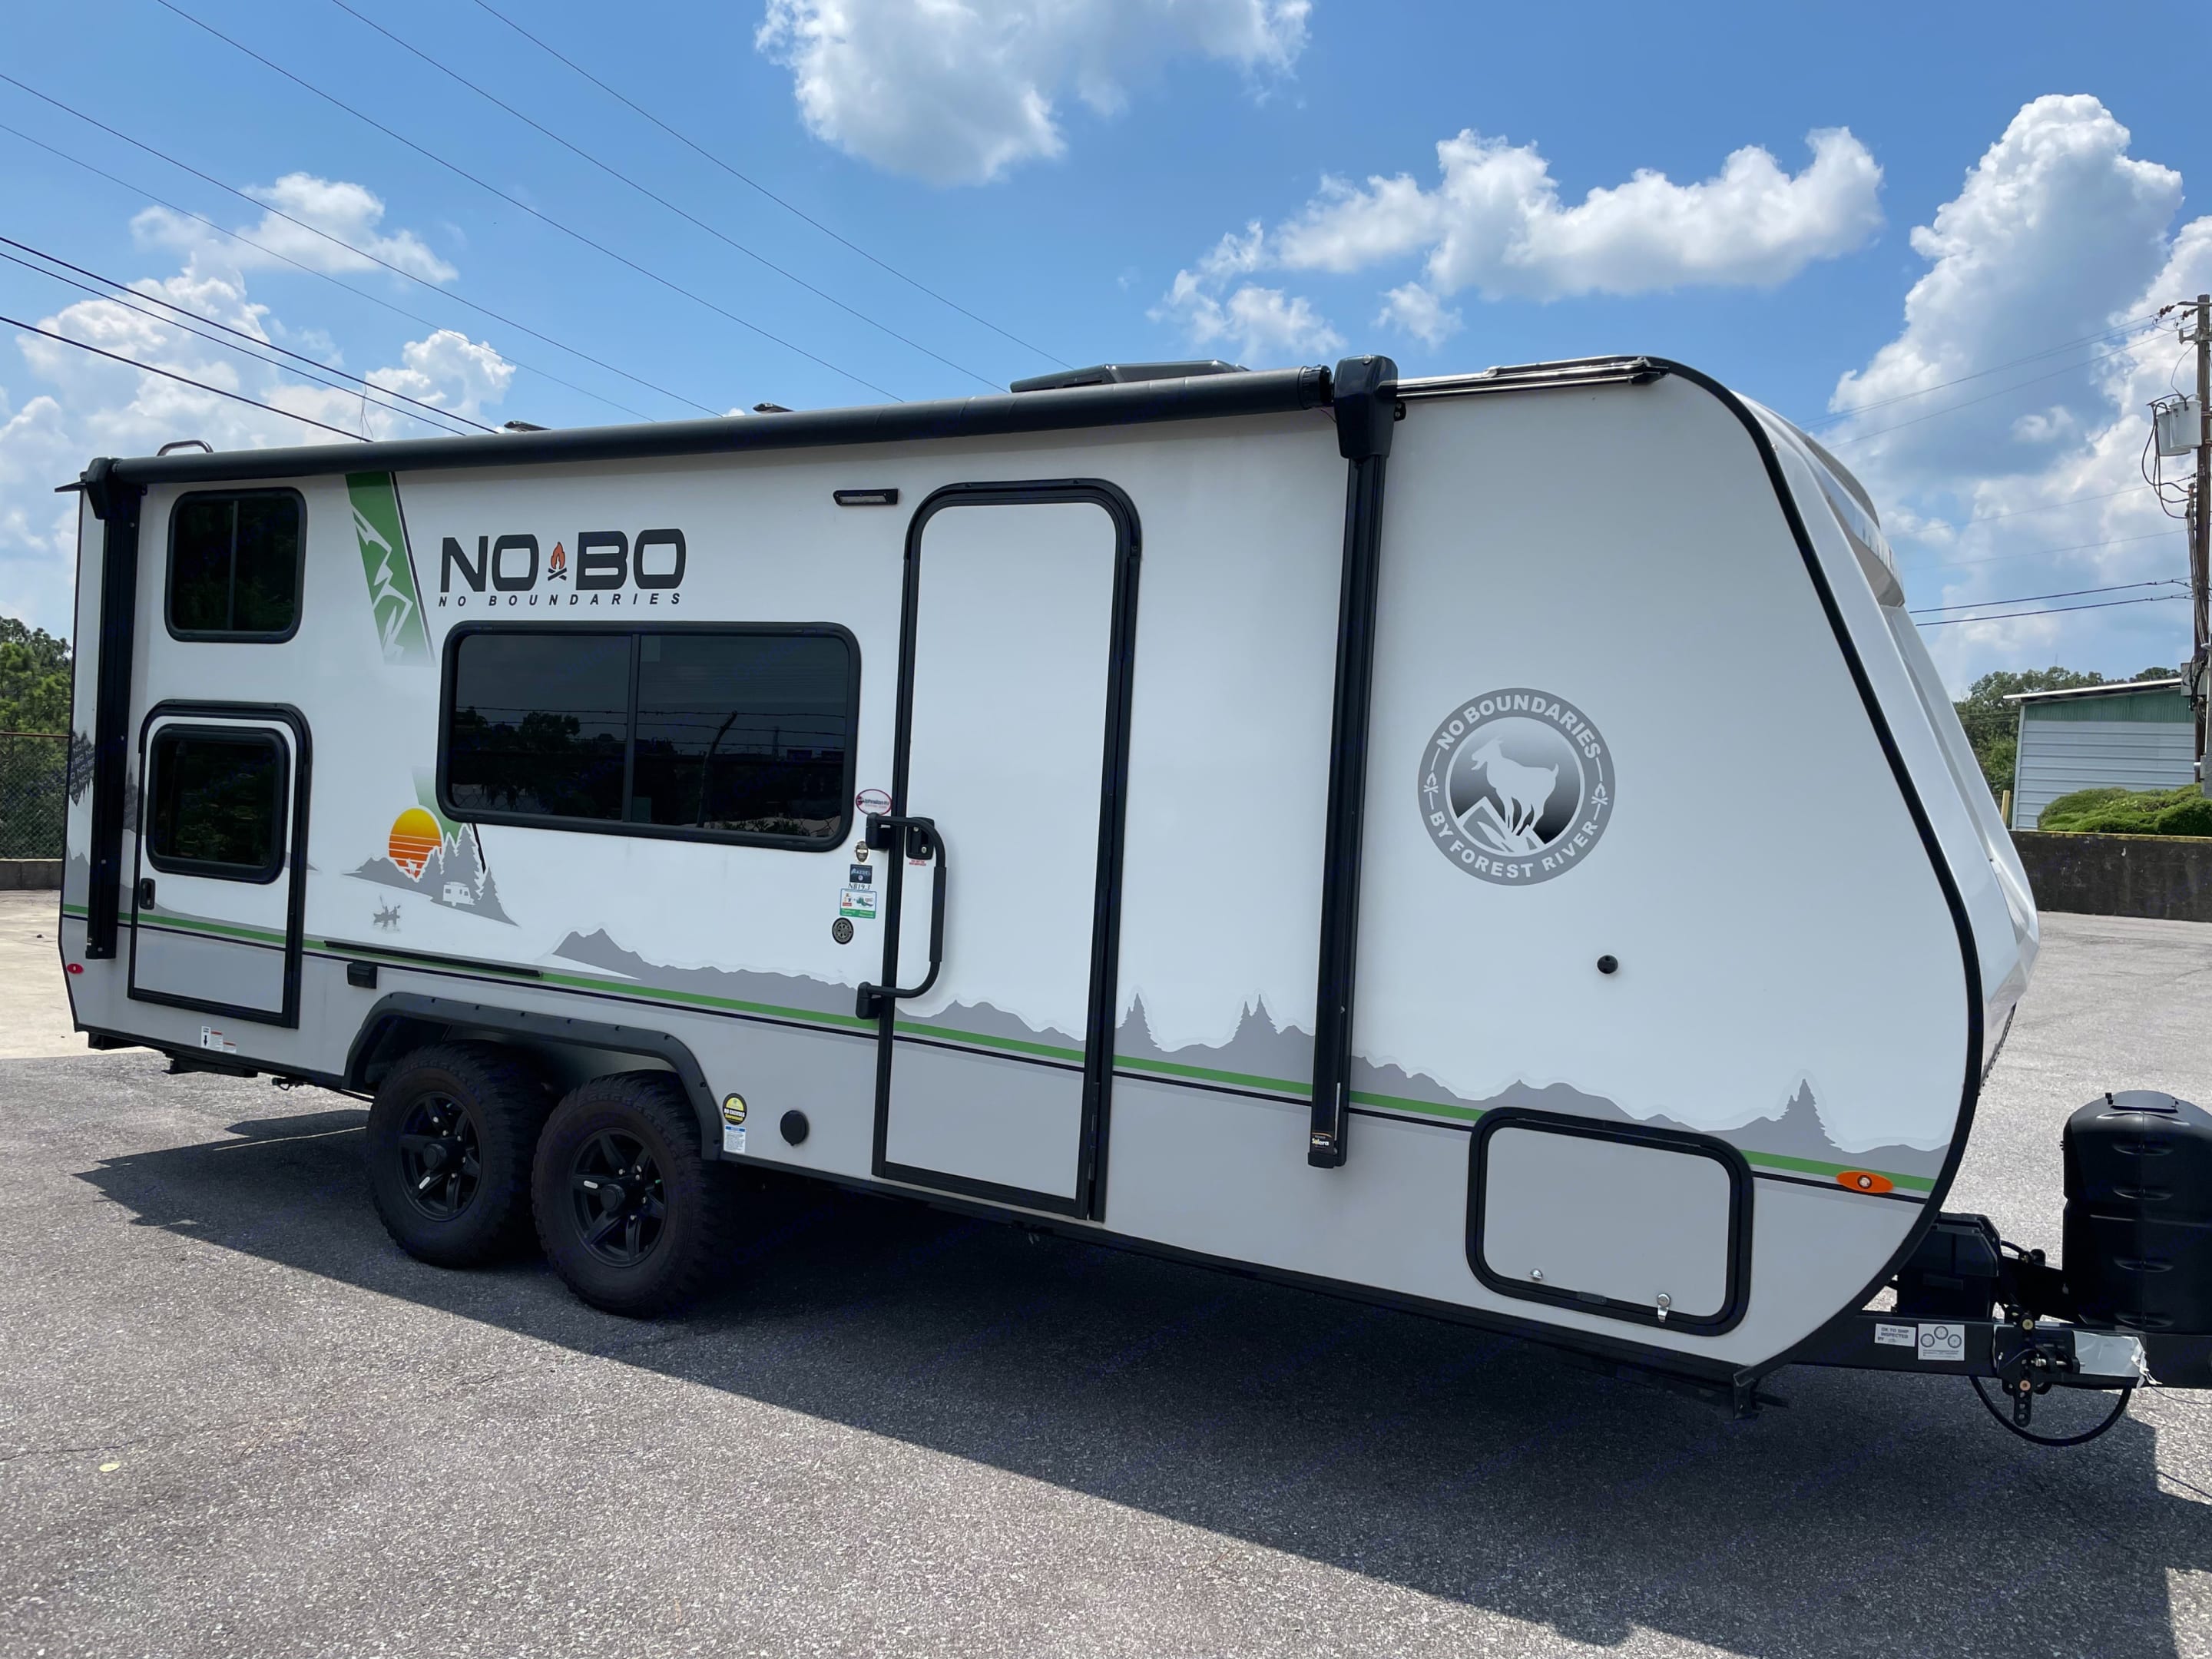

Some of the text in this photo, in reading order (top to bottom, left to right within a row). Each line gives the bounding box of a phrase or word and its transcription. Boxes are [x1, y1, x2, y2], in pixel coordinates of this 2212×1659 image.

[439, 593, 680, 607] NO BOUNDARIES
[1436, 694, 1601, 759] NO BOUNDARIES
[1429, 811, 1598, 878] BY FOREST RIVER
